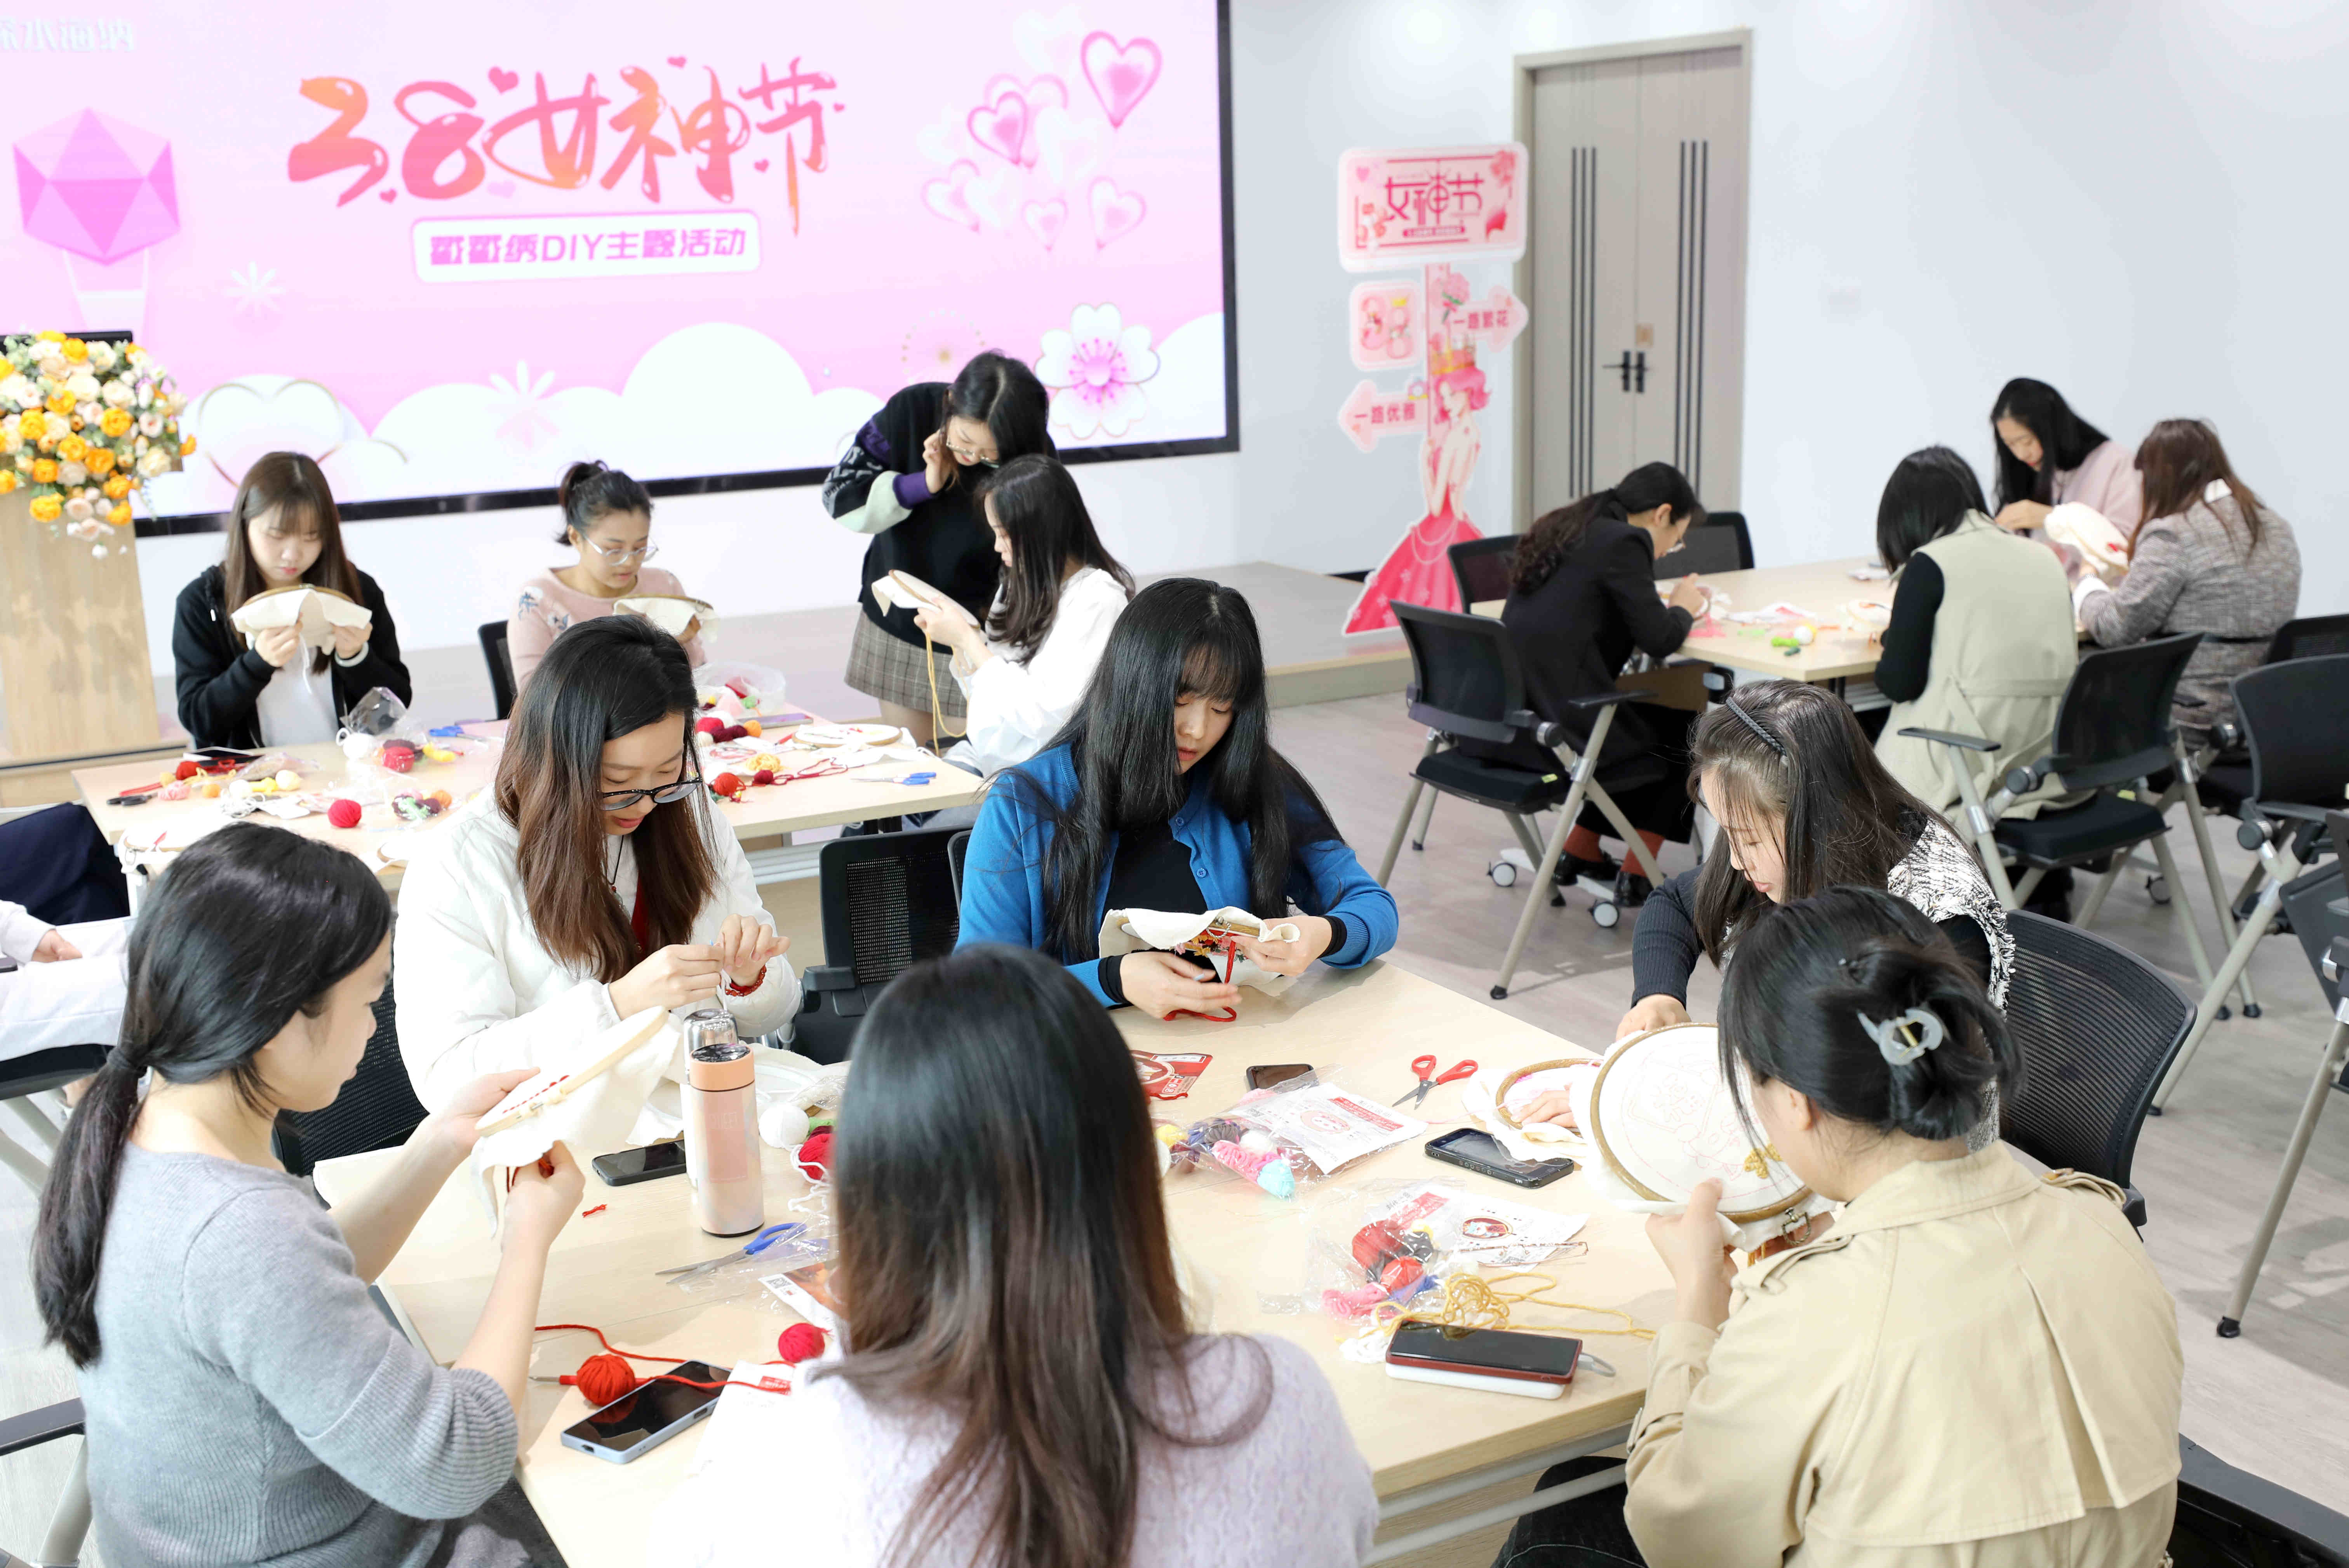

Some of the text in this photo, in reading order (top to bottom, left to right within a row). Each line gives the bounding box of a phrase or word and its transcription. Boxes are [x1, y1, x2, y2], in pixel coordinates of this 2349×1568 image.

[1384, 171, 1485, 224] 女神节
[430, 228, 746, 266] 戳戳绣DIY主题活动
